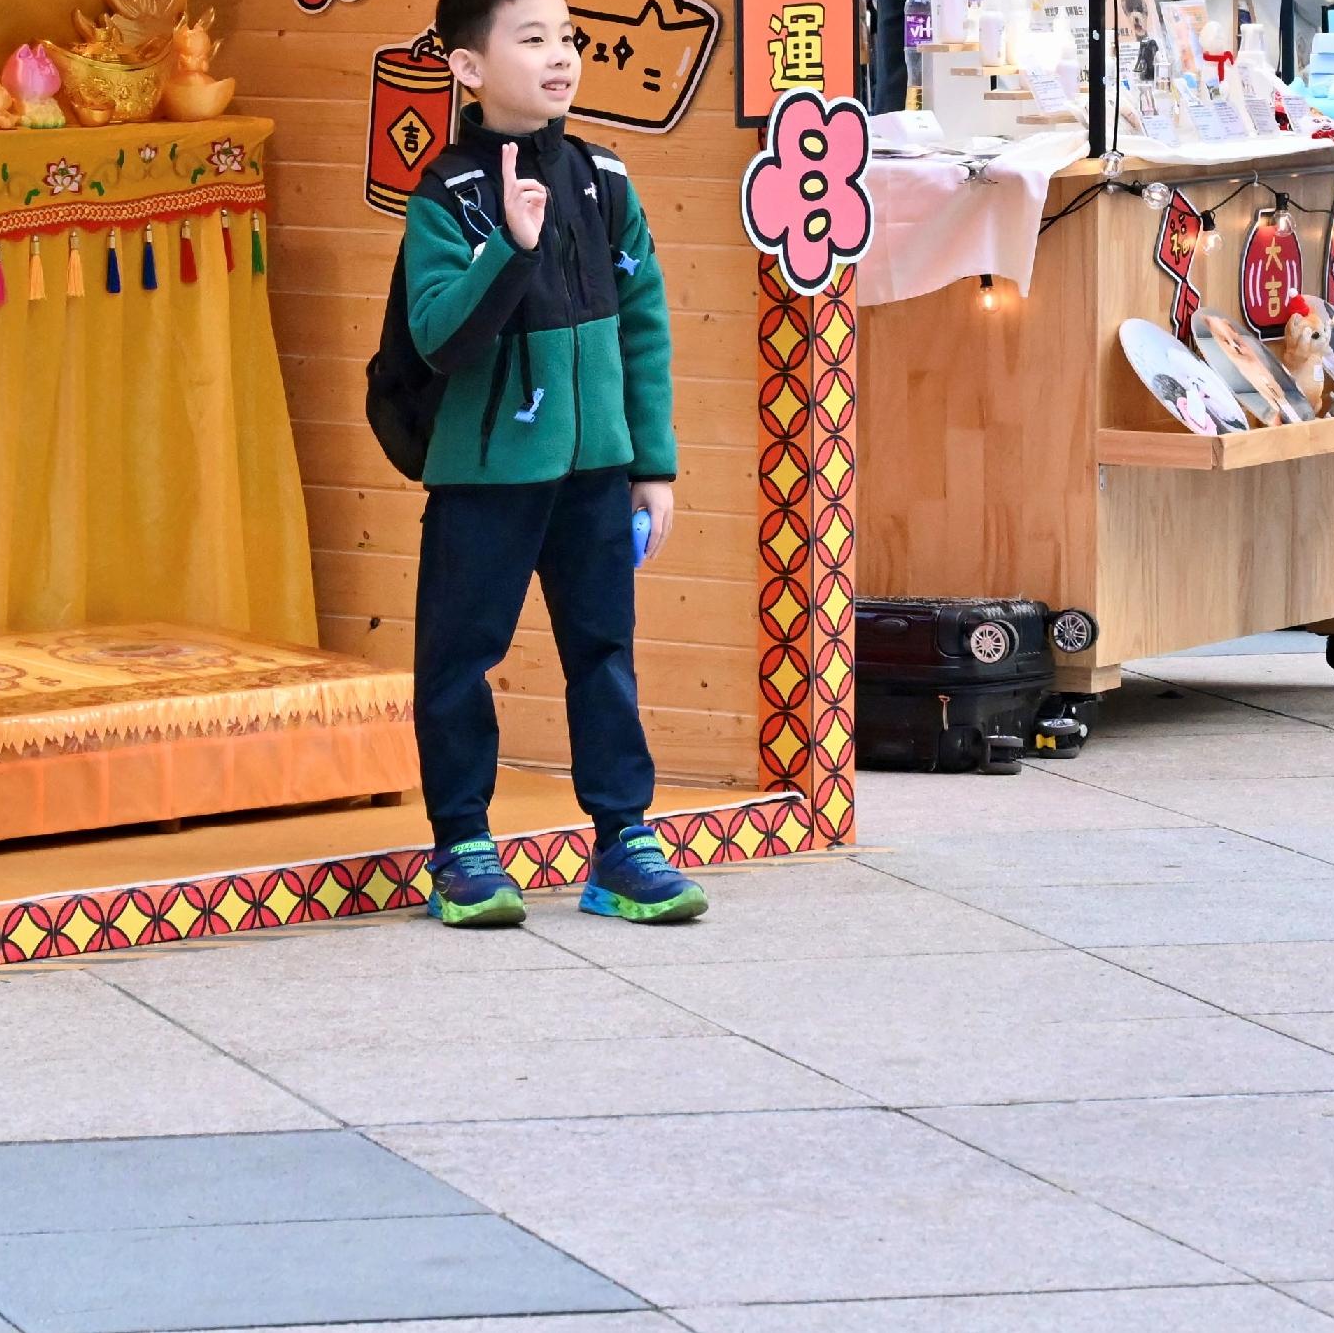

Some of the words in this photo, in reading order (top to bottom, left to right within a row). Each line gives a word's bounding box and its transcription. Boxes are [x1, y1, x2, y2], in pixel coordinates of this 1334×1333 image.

[402, 118, 421, 154] 吉
[1170, 214, 1190, 265] 福
[1264, 235, 1284, 318] 大吉
